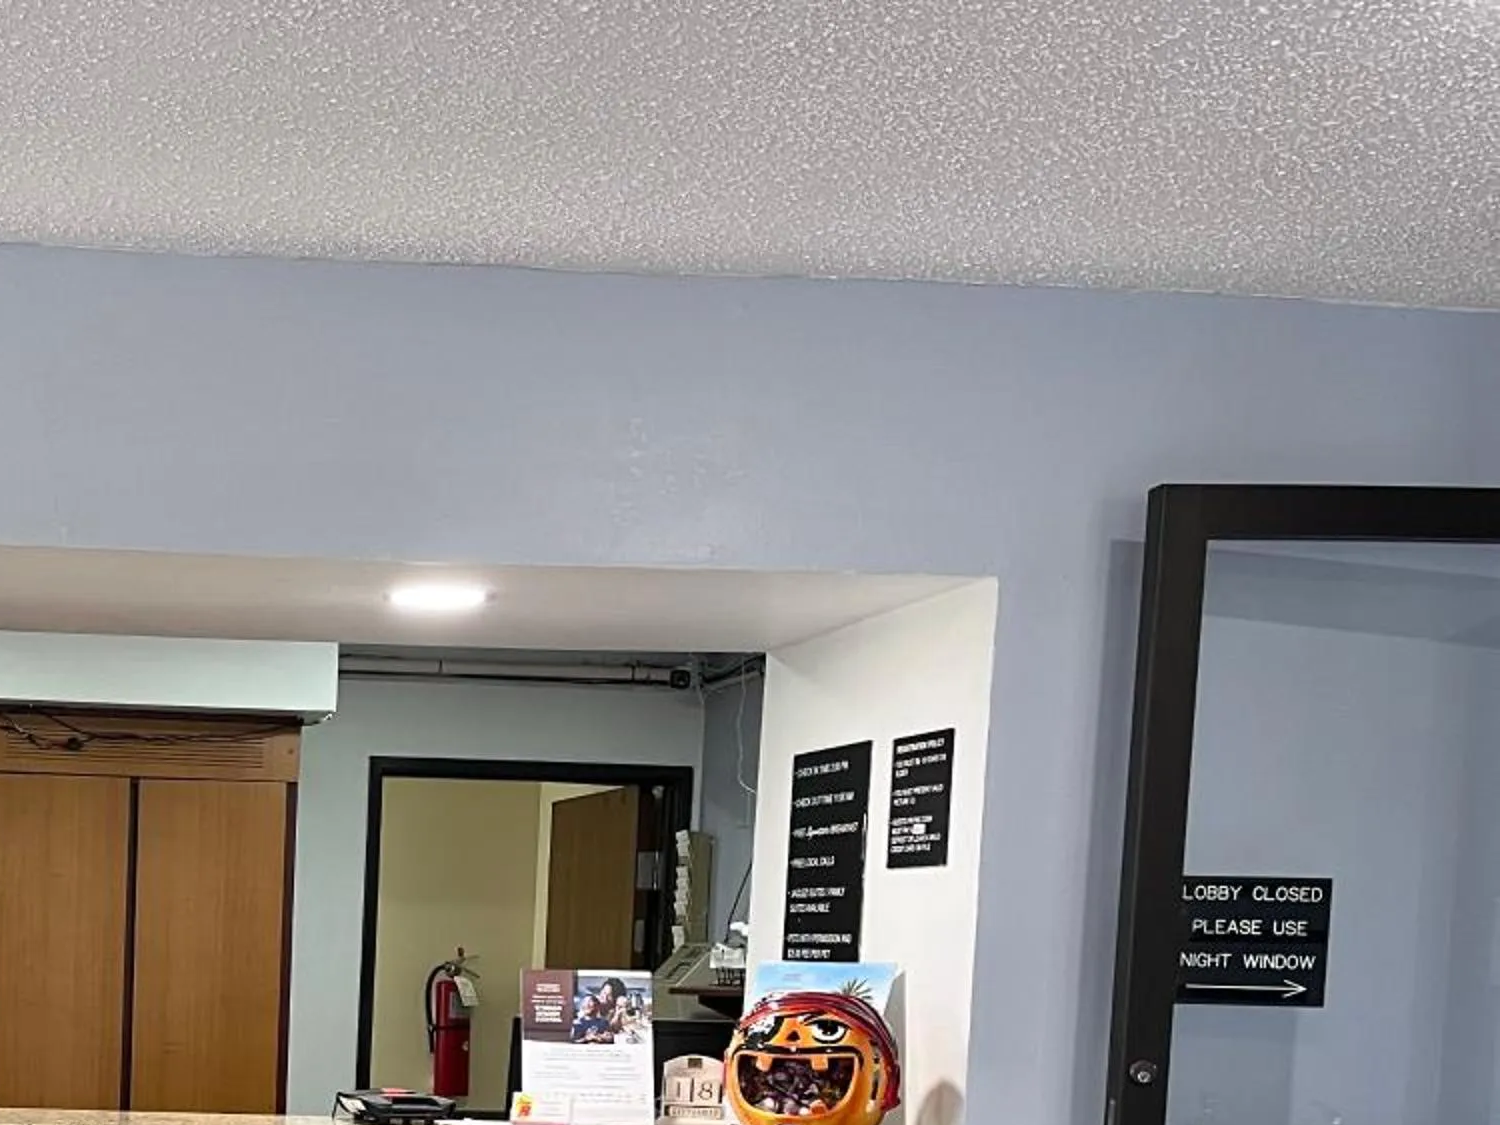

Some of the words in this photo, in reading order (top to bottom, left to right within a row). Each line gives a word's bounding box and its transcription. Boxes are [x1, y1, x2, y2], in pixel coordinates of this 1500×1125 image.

[1181, 884, 1243, 901] LOBBY
[1252, 886, 1323, 903] CLOSED
[1191, 918, 1263, 935] PLEASE
[1273, 920, 1308, 937] USE
[1179, 951, 1233, 969] NIGHT
[1243, 953, 1317, 970] WINDOW
